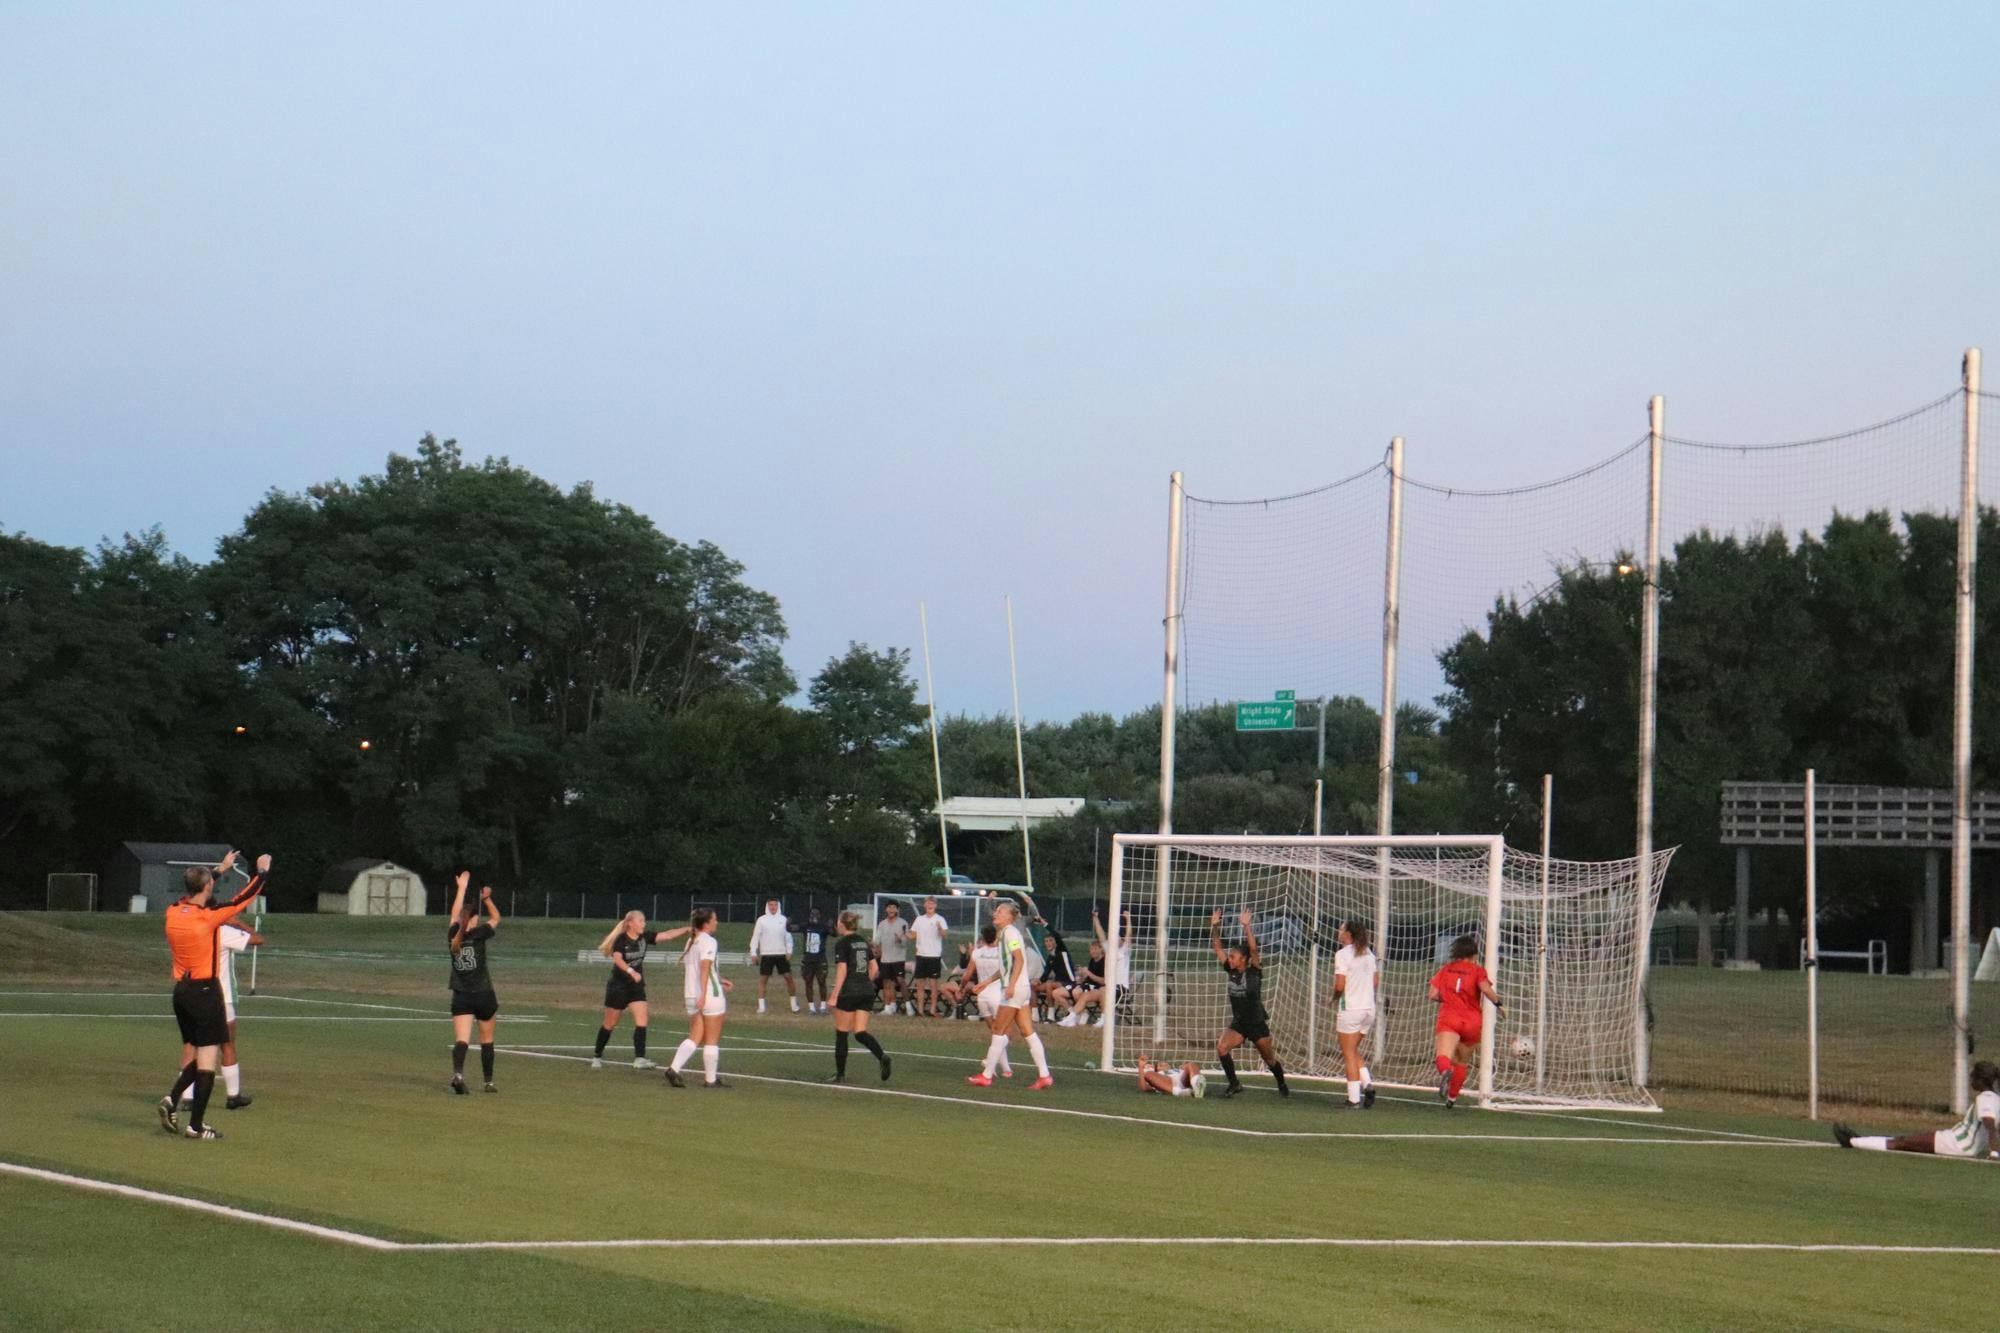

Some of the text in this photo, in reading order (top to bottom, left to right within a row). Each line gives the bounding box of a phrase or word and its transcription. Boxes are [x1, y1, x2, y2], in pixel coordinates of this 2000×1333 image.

[1264, 706, 1282, 715] State
[1243, 718, 1278, 727] University
[1455, 977, 1463, 994] 1
